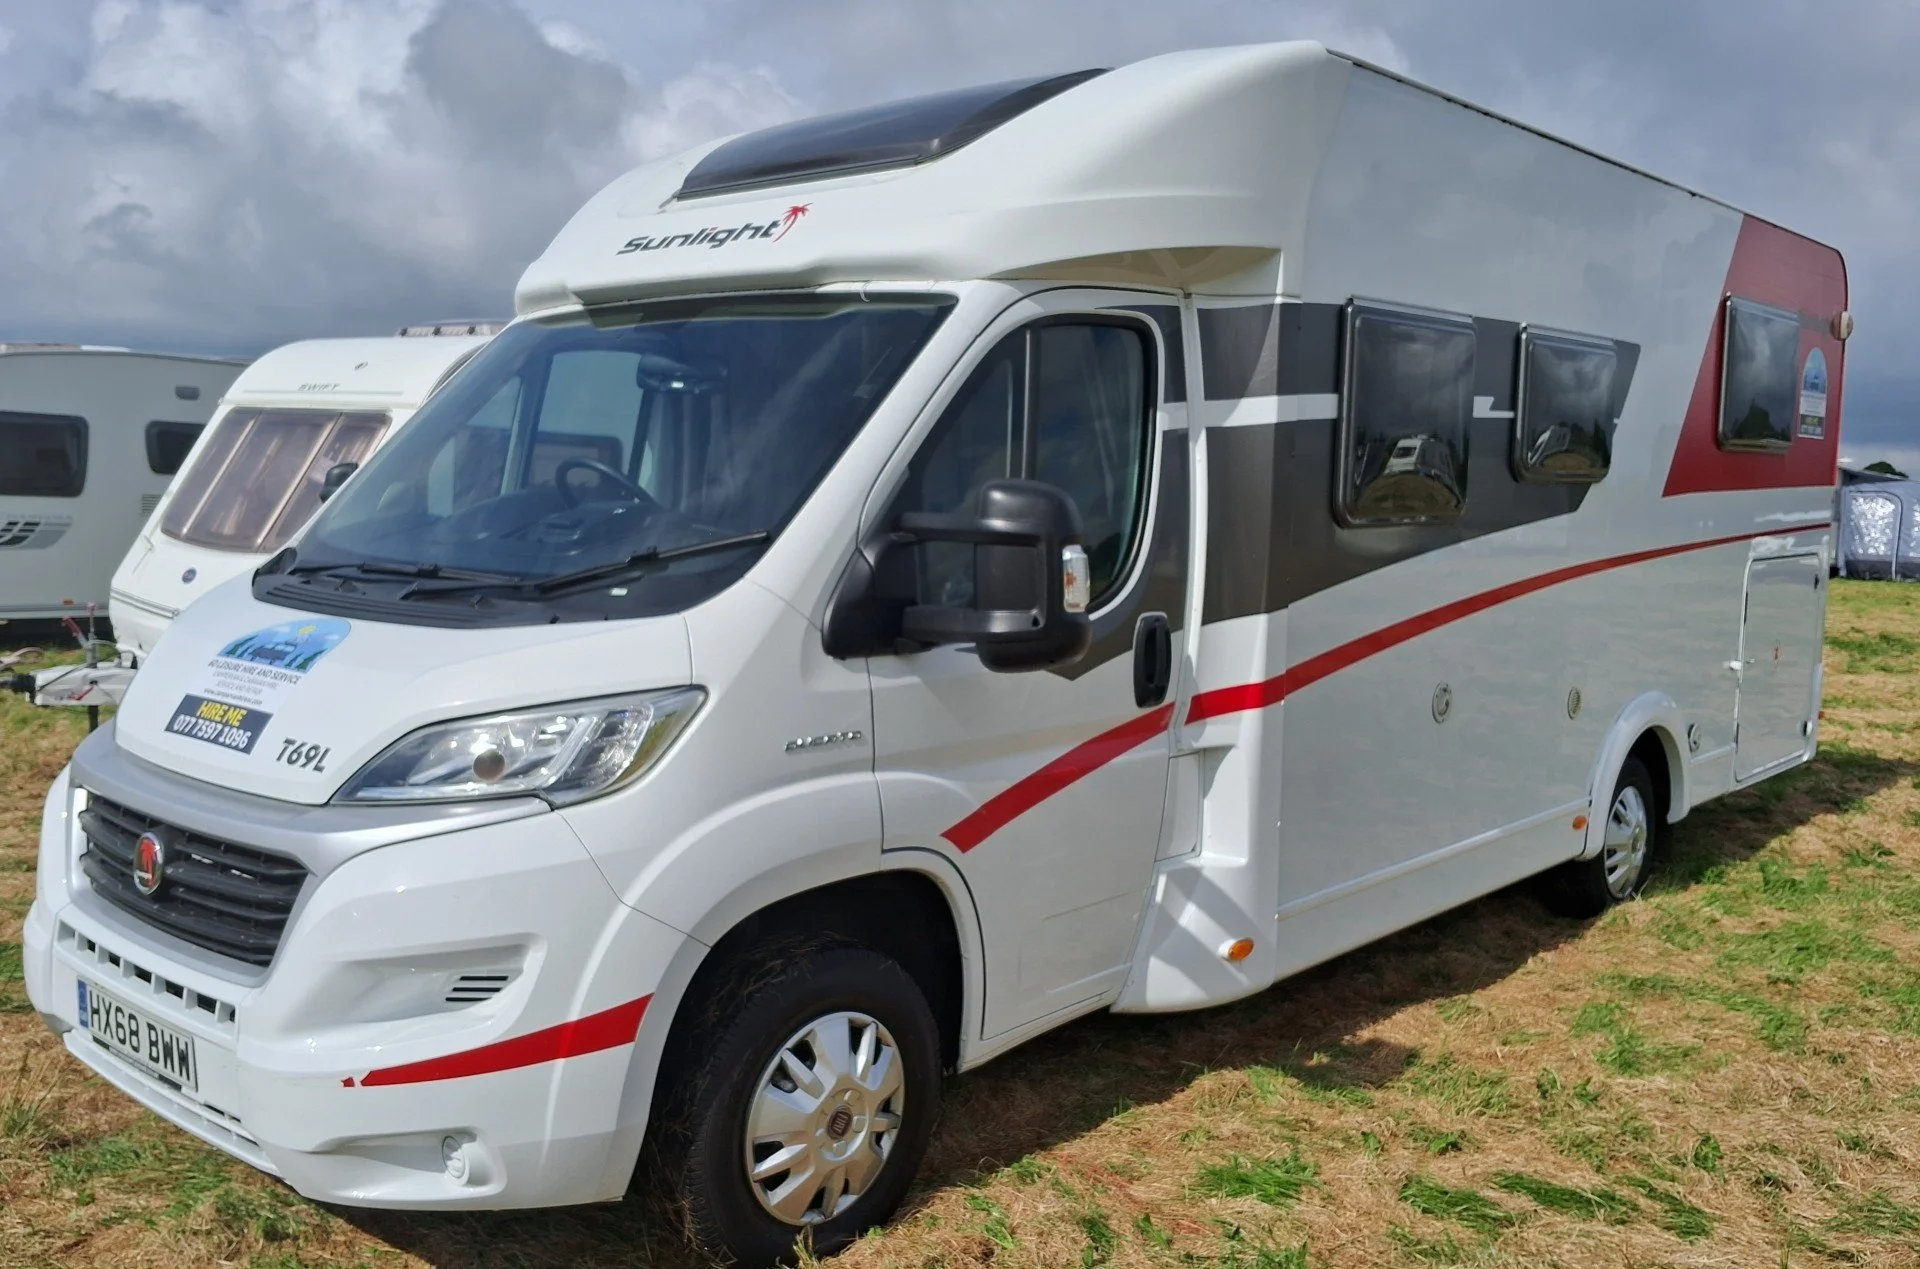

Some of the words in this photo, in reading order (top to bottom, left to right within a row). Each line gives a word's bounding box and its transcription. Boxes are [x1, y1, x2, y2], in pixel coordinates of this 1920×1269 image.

[615, 219, 781, 256] Sunlight
[217, 660, 243, 672] LEISURE
[241, 665, 259, 675] HIRE
[257, 667, 273, 678] AND
[270, 671, 302, 684] SERVICE
[196, 701, 225, 724] HIRE
[222, 706, 247, 727] ME
[173, 715, 195, 733] 077
[192, 718, 221, 741] 7597
[218, 727, 251, 749] 1096
[276, 737, 331, 773] T69L
[89, 989, 140, 1054] HX68
[146, 1021, 190, 1081] BWW
